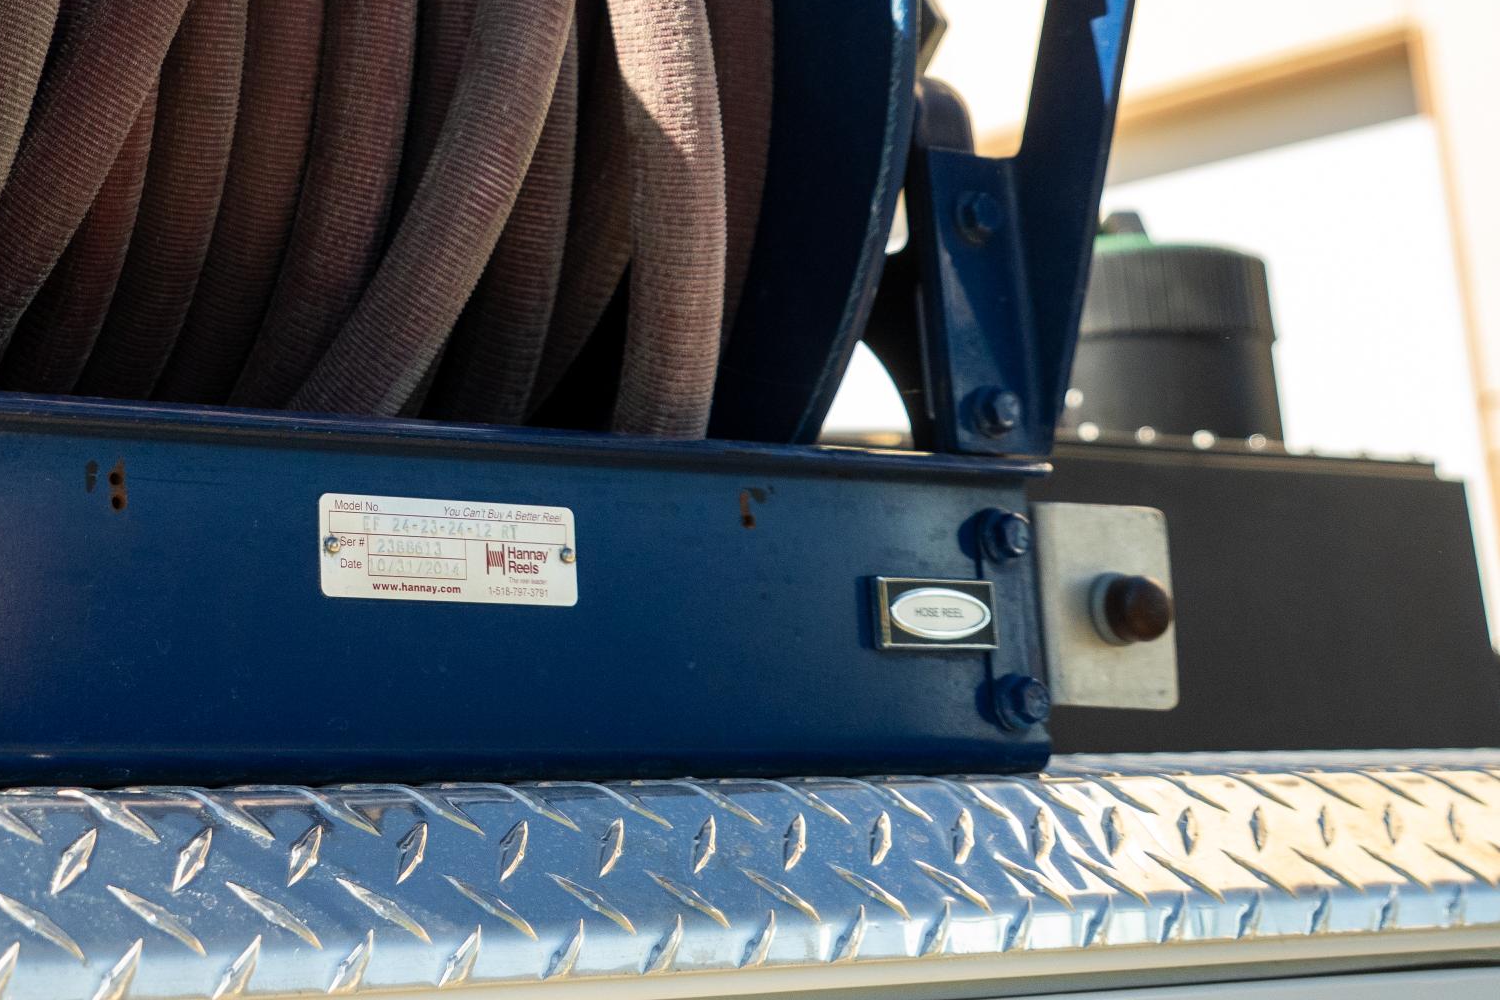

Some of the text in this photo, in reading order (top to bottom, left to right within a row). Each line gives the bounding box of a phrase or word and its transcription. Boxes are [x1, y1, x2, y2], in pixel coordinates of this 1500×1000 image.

[334, 499, 363, 511] Model
[444, 506, 563, 522] You Can't Buy A Better Reel
[340, 536, 365, 547] Ser #
[508, 546, 548, 564] Hannay
[340, 558, 362, 569] Date
[508, 560, 539, 574] Reels
[372, 582, 461, 594] www.hannay.com
[488, 586, 548, 598] 1-518-797-3791
[915, 607, 964, 618] HOSE REEL
